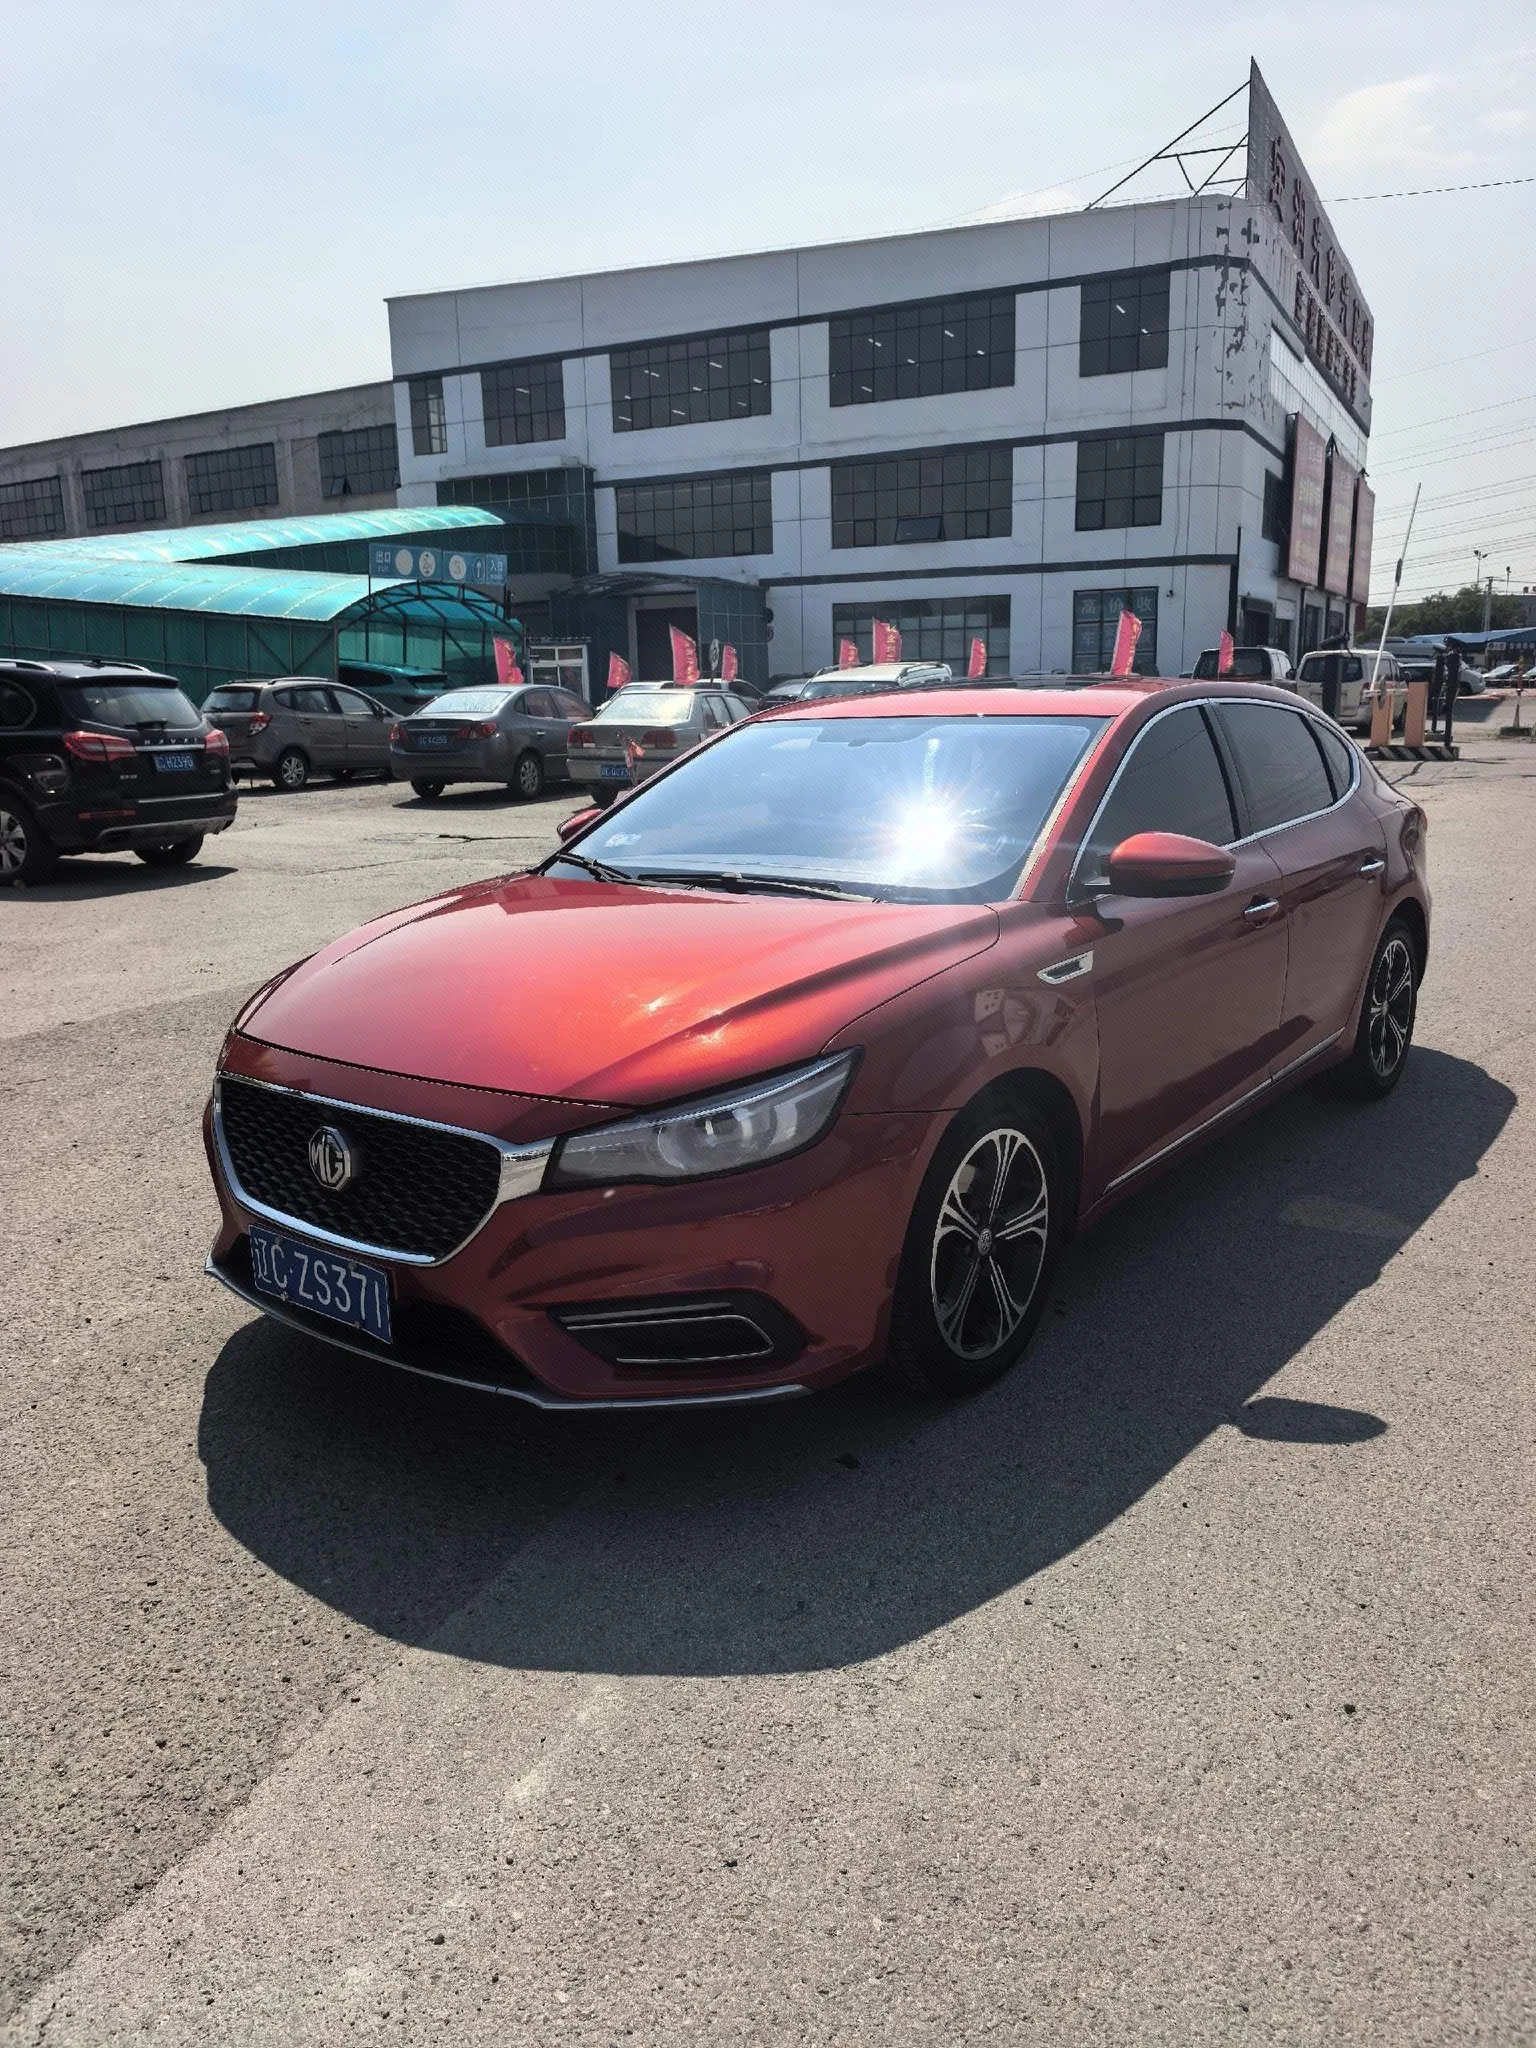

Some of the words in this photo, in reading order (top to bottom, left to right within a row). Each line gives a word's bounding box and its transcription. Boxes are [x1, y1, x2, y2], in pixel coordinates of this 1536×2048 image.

[375, 550, 391, 563] 出口
[489, 560, 503, 571] 入口
[311, 1132, 344, 1185] MG
